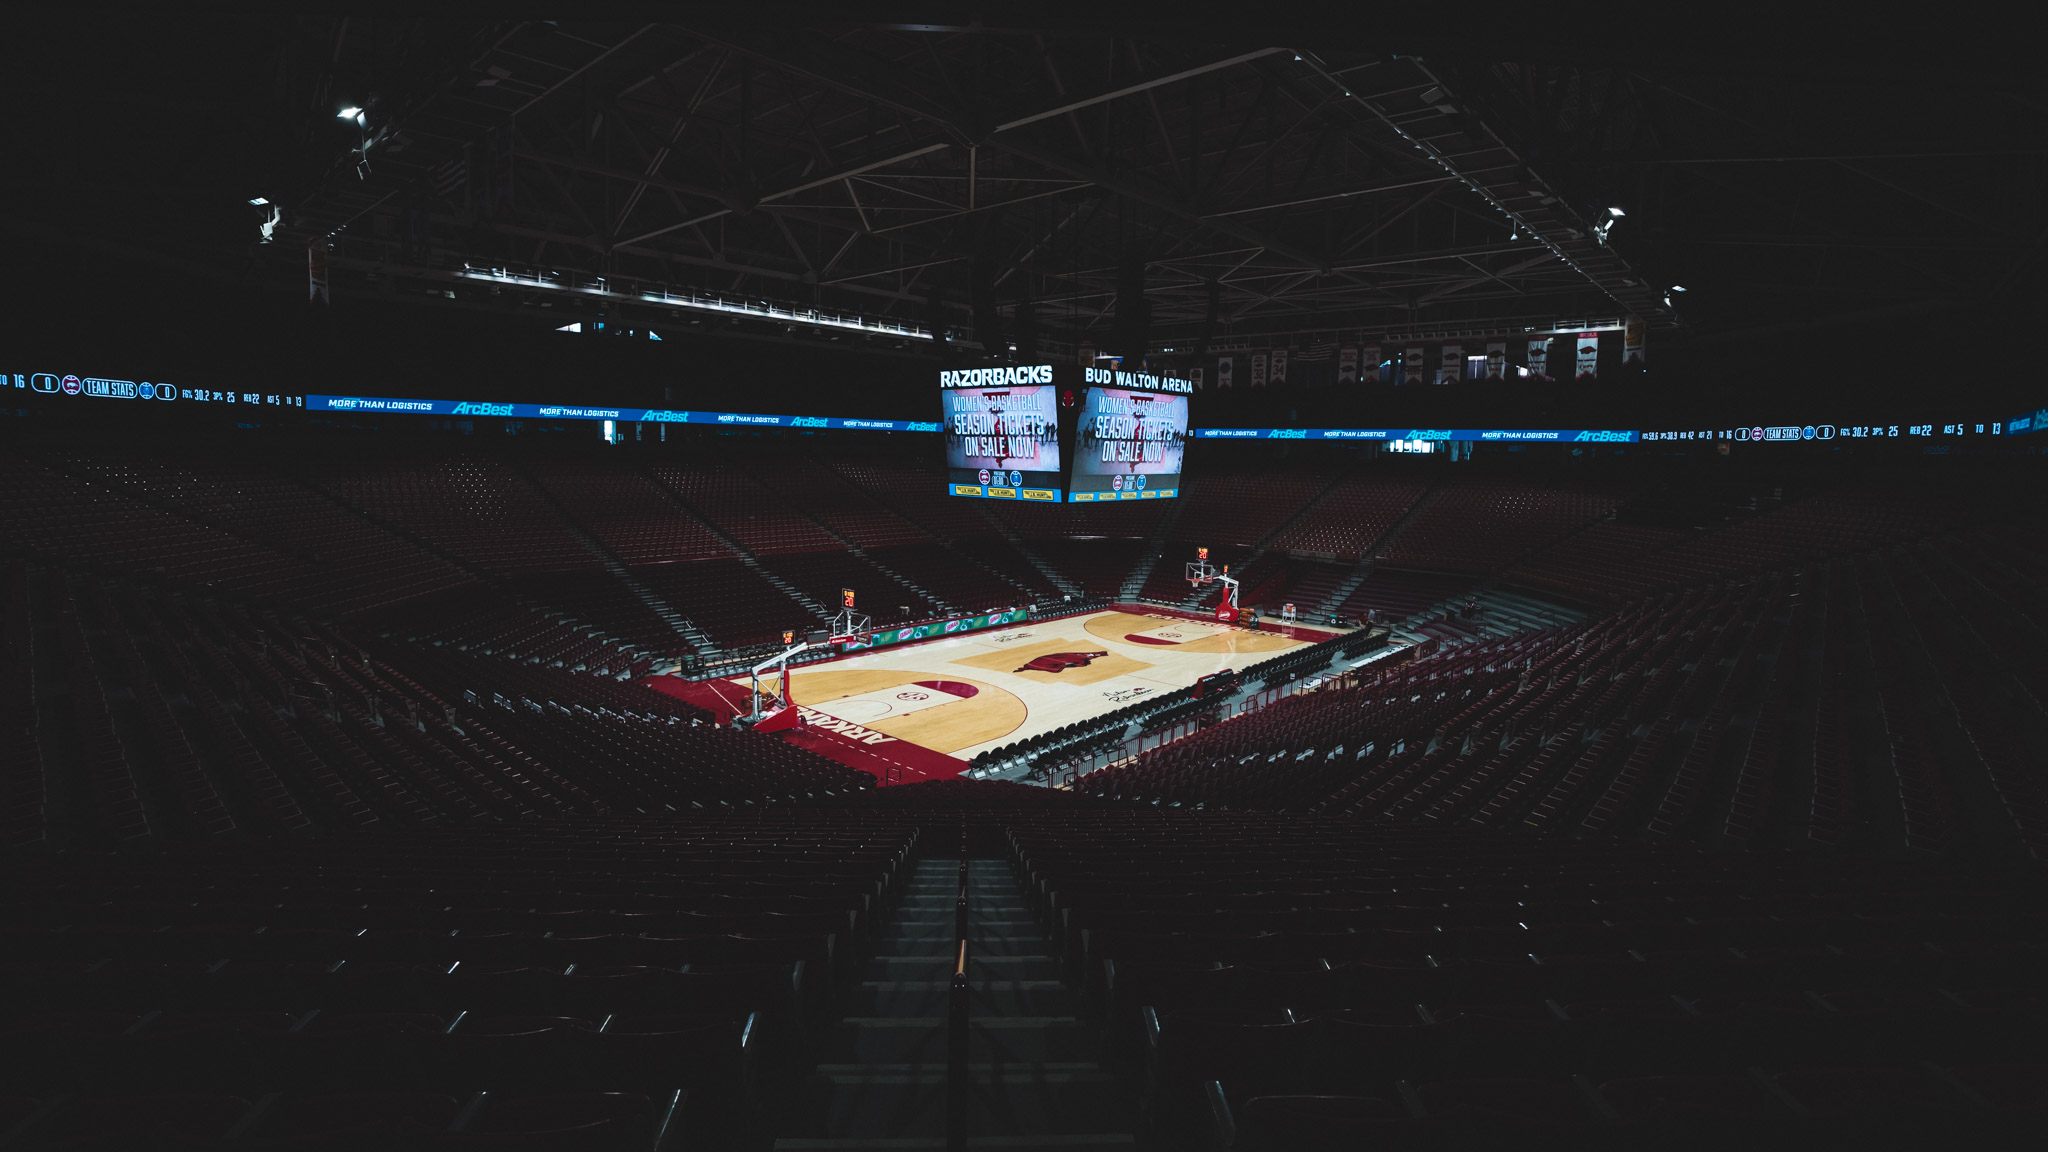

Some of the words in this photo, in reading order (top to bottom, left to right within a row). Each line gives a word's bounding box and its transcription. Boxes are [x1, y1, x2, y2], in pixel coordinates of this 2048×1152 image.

[14, 374, 25, 388] 16
[44, 376, 52, 390] 0
[940, 365, 1053, 388] RAZORBACKS
[1085, 367, 1112, 384] BUD
[1115, 369, 1159, 390] WALTON
[1161, 374, 1193, 394] ARENA
[86, 380, 109, 395] TEAM
[111, 382, 134, 397] STATS
[164, 386, 170, 398] 0
[194, 389, 210, 401] 30.2
[227, 392, 236, 403] 25
[252, 394, 260, 404] 22
[276, 395, 280, 406] 5
[296, 396, 302, 407] 13
[328, 399, 356, 408] MORE
[358, 400, 384, 410] THAN
[386, 402, 432, 410] LOGISTICS
[952, 396, 988, 412] WOMEN'S
[990, 394, 1042, 411] BASKETBALL
[452, 402, 514, 416] ArcBest
[540, 408, 560, 416] MORE
[562, 408, 582, 416] THAN
[584, 410, 619, 418] LOGISTICS
[1098, 396, 1134, 415] WOMEN'S
[1136, 398, 1176, 418] BASKETBALL
[641, 410, 689, 422] ArcBest
[752, 416, 780, 424] LOGISTICS
[790, 416, 828, 428] ArcBest
[906, 422, 937, 432] ArcBest
[954, 414, 995, 435] SEASON
[998, 412, 1044, 434] TICKETS
[1095, 416, 1136, 440] SEASON
[1138, 418, 1174, 441] TICKETS
[1852, 426, 1868, 438] 30.2
[1888, 425, 1898, 437] 25
[1910, 426, 1920, 436] REB
[1922, 425, 1932, 436] 22
[1944, 425, 1954, 434] AST
[1957, 424, 1963, 436] 5
[1976, 424, 1984, 434] TO
[1992, 422, 2001, 434] 13
[1268, 429, 1307, 439] ArcBest
[1405, 430, 1452, 440] ArcBest
[1574, 430, 1632, 442] ArcBest
[1688, 431, 1694, 440] 42
[1706, 430, 1712, 439] 21
[1742, 430, 1746, 439] 0
[1766, 428, 1781, 439] TEAM
[1782, 428, 1799, 439] STATS
[1824, 427, 1829, 438] 0
[965, 438, 978, 456] ON
[981, 438, 1006, 458] SALE
[1008, 438, 1035, 458] NOW
[1102, 441, 1116, 462] ON
[1118, 442, 1139, 462] SALE
[1141, 443, 1165, 463] NOW
[845, 596, 854, 607] 20
[797, 705, 898, 745] ARKAN
